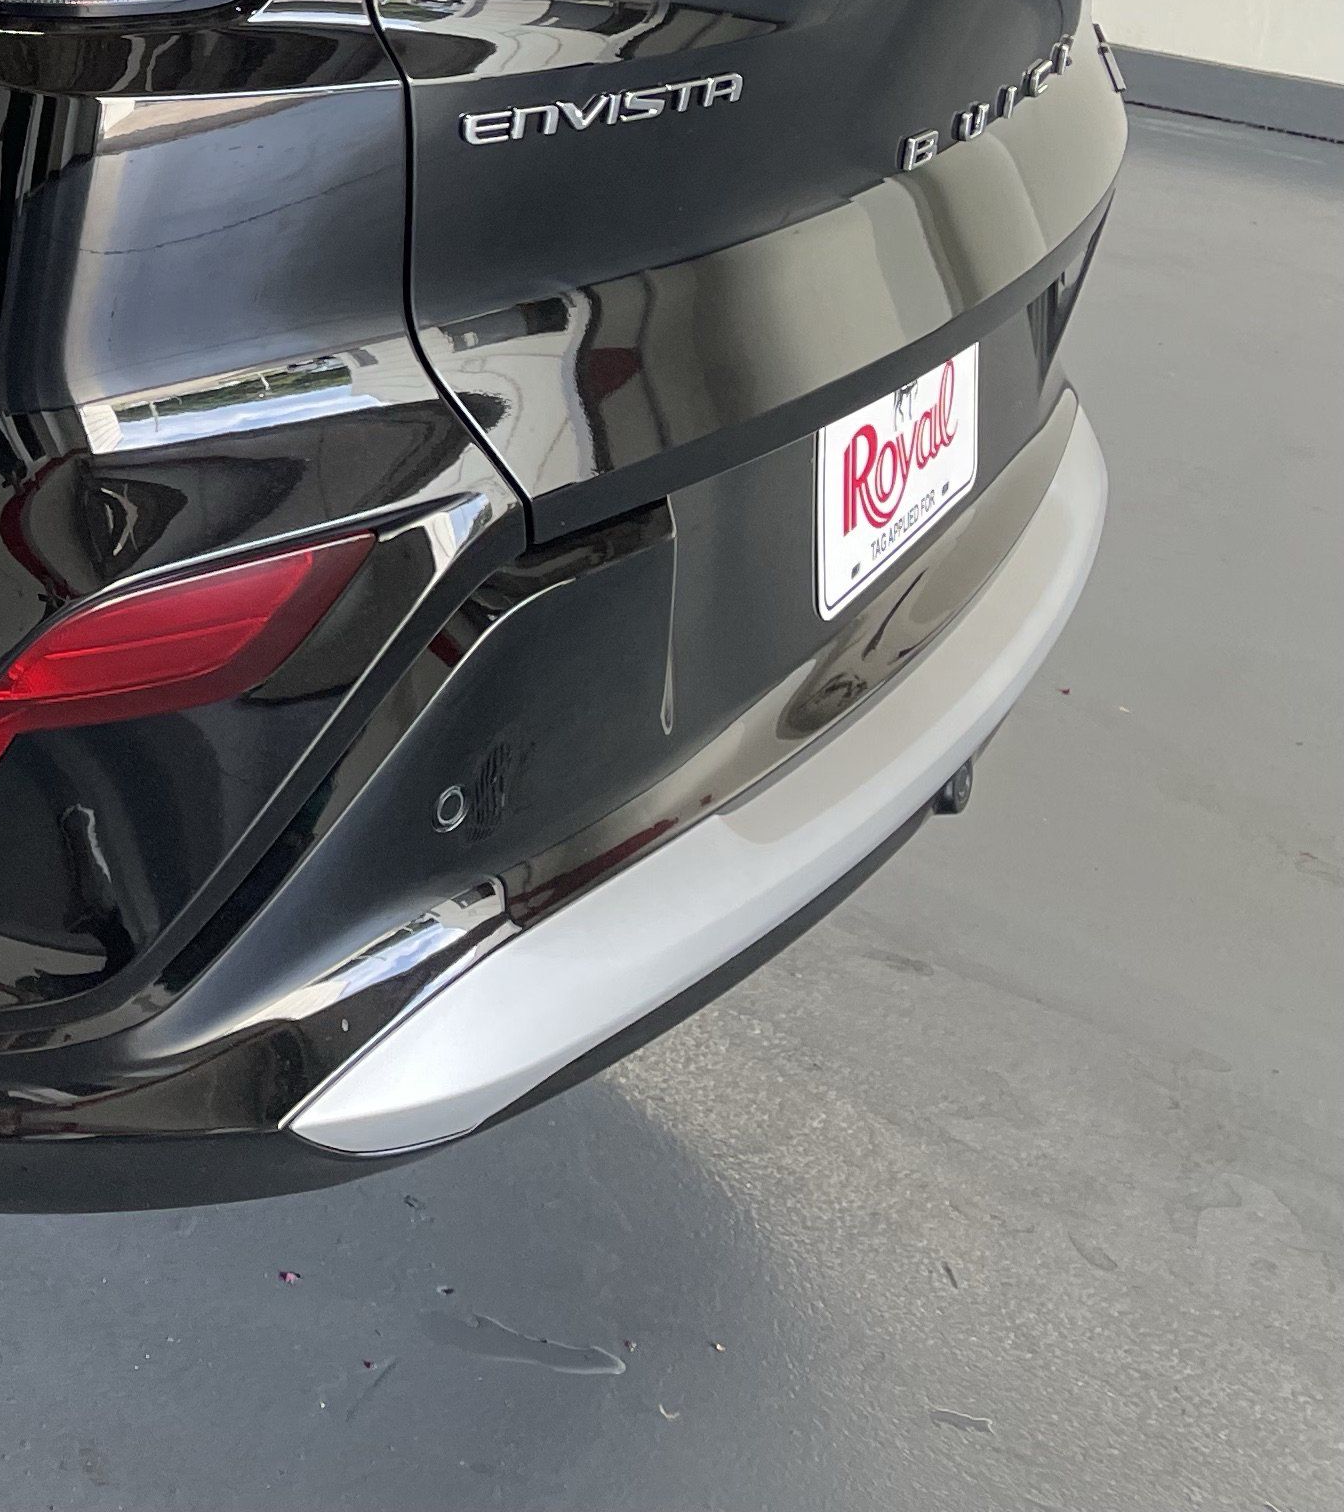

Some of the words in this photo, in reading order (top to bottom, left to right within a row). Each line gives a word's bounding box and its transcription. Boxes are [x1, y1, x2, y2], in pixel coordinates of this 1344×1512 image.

[458, 72, 744, 146] ENVISTA
[870, 532, 887, 561] TAG
[888, 504, 920, 547] APPLIED
[920, 489, 936, 517] FOR
